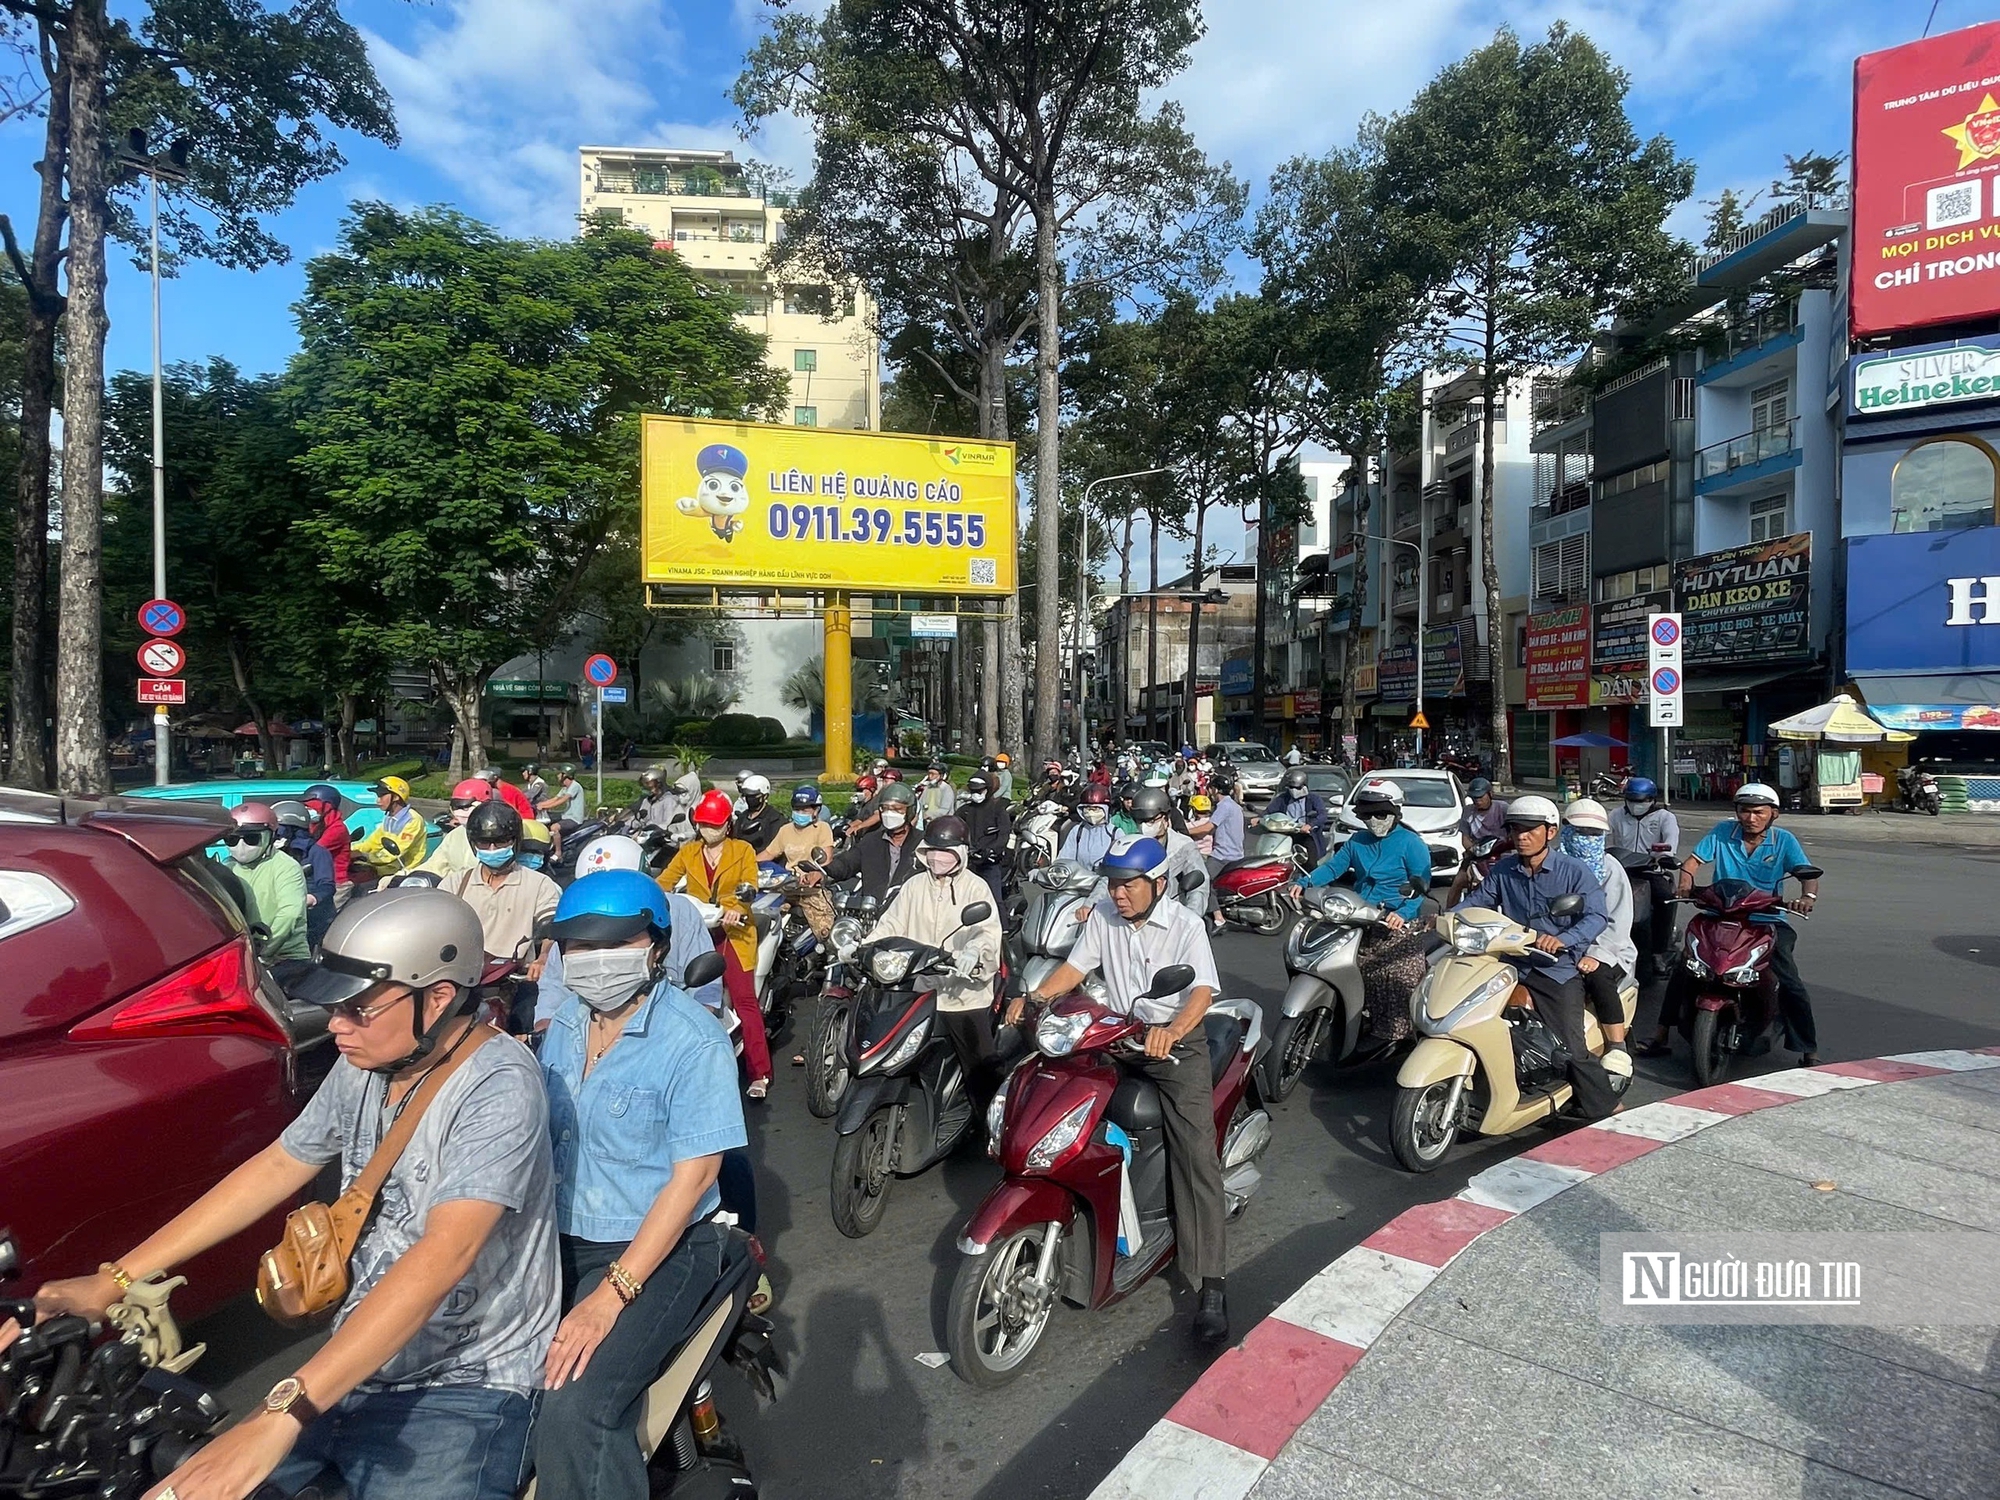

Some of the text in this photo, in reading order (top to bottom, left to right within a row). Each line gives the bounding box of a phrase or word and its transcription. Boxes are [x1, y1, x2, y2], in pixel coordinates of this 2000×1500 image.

[1883, 96, 1918, 110] TRUNG
[1918, 90, 1940, 102] TÂM
[1941, 85, 1957, 97] DỮ
[1958, 80, 1979, 92] LIỆU
[1882, 240, 1919, 259] MỌI
[1926, 229, 1974, 250] DỊCH
[1874, 251, 2000, 290] CHỈ TRON
[1899, 352, 1977, 382] SILVER
[962, 453, 995, 462] VINAMA
[769, 468, 961, 502] LIÊN HỆ QUẢNG CÁO
[768, 502, 986, 548] 0911.39.5555
[668, 566, 692, 575] VINAMA
[712, 569, 734, 577] DOANH
[734, 568, 757, 578] NGHIỆP
[758, 570, 776, 578] HÀNG
[777, 569, 790, 579] ĐẦU
[791, 570, 805, 579] LĨNH
[806, 572, 819, 580] VỰC
[1687, 580, 1791, 611] DÁN KEO XE
[1698, 621, 1719, 634] TEM
[1720, 619, 1734, 631] XE
[1735, 617, 1754, 629] HƠI
[1761, 614, 1776, 626] XE
[1778, 610, 1805, 625] MÁY
[152, 681, 172, 692] CẤM
[492, 684, 506, 692] NHÀ
[506, 682, 513, 692] VỆ
[1600, 674, 1633, 697] DÁN
